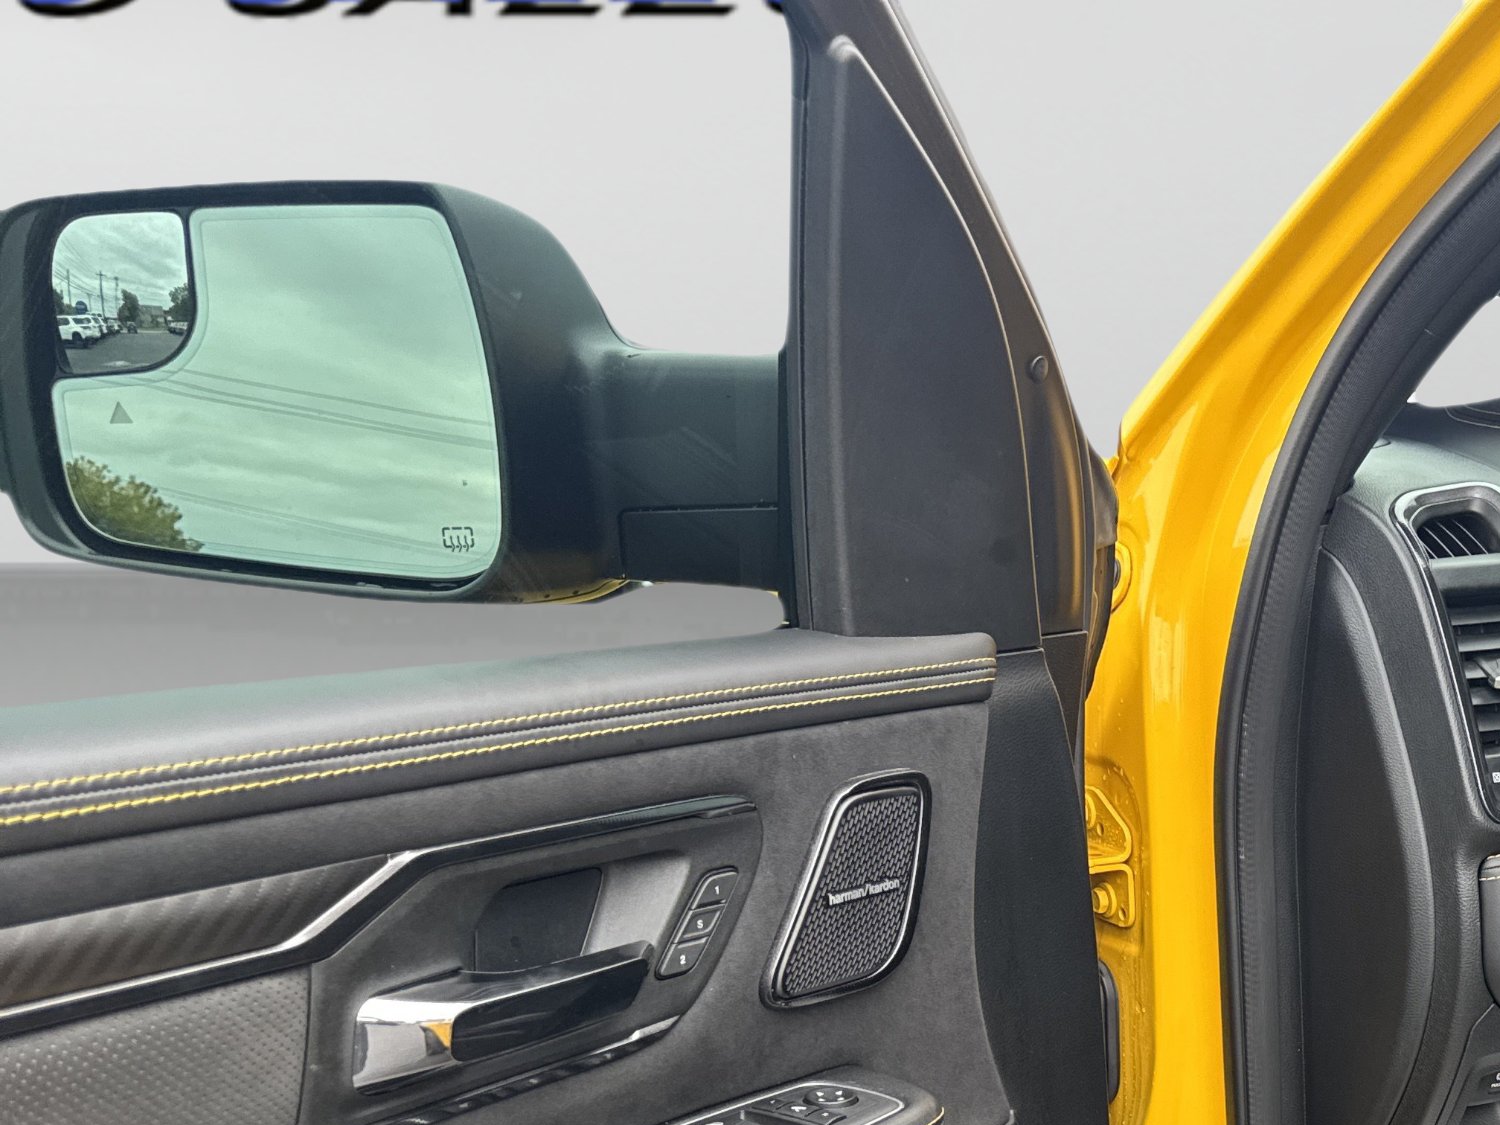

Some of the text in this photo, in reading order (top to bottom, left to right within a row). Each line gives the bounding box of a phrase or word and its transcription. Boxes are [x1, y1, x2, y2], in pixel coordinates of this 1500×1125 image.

[714, 885, 719, 895] 1
[827, 878, 900, 906] harman/kardon
[697, 919, 704, 929] S
[680, 954, 686, 965] 2
